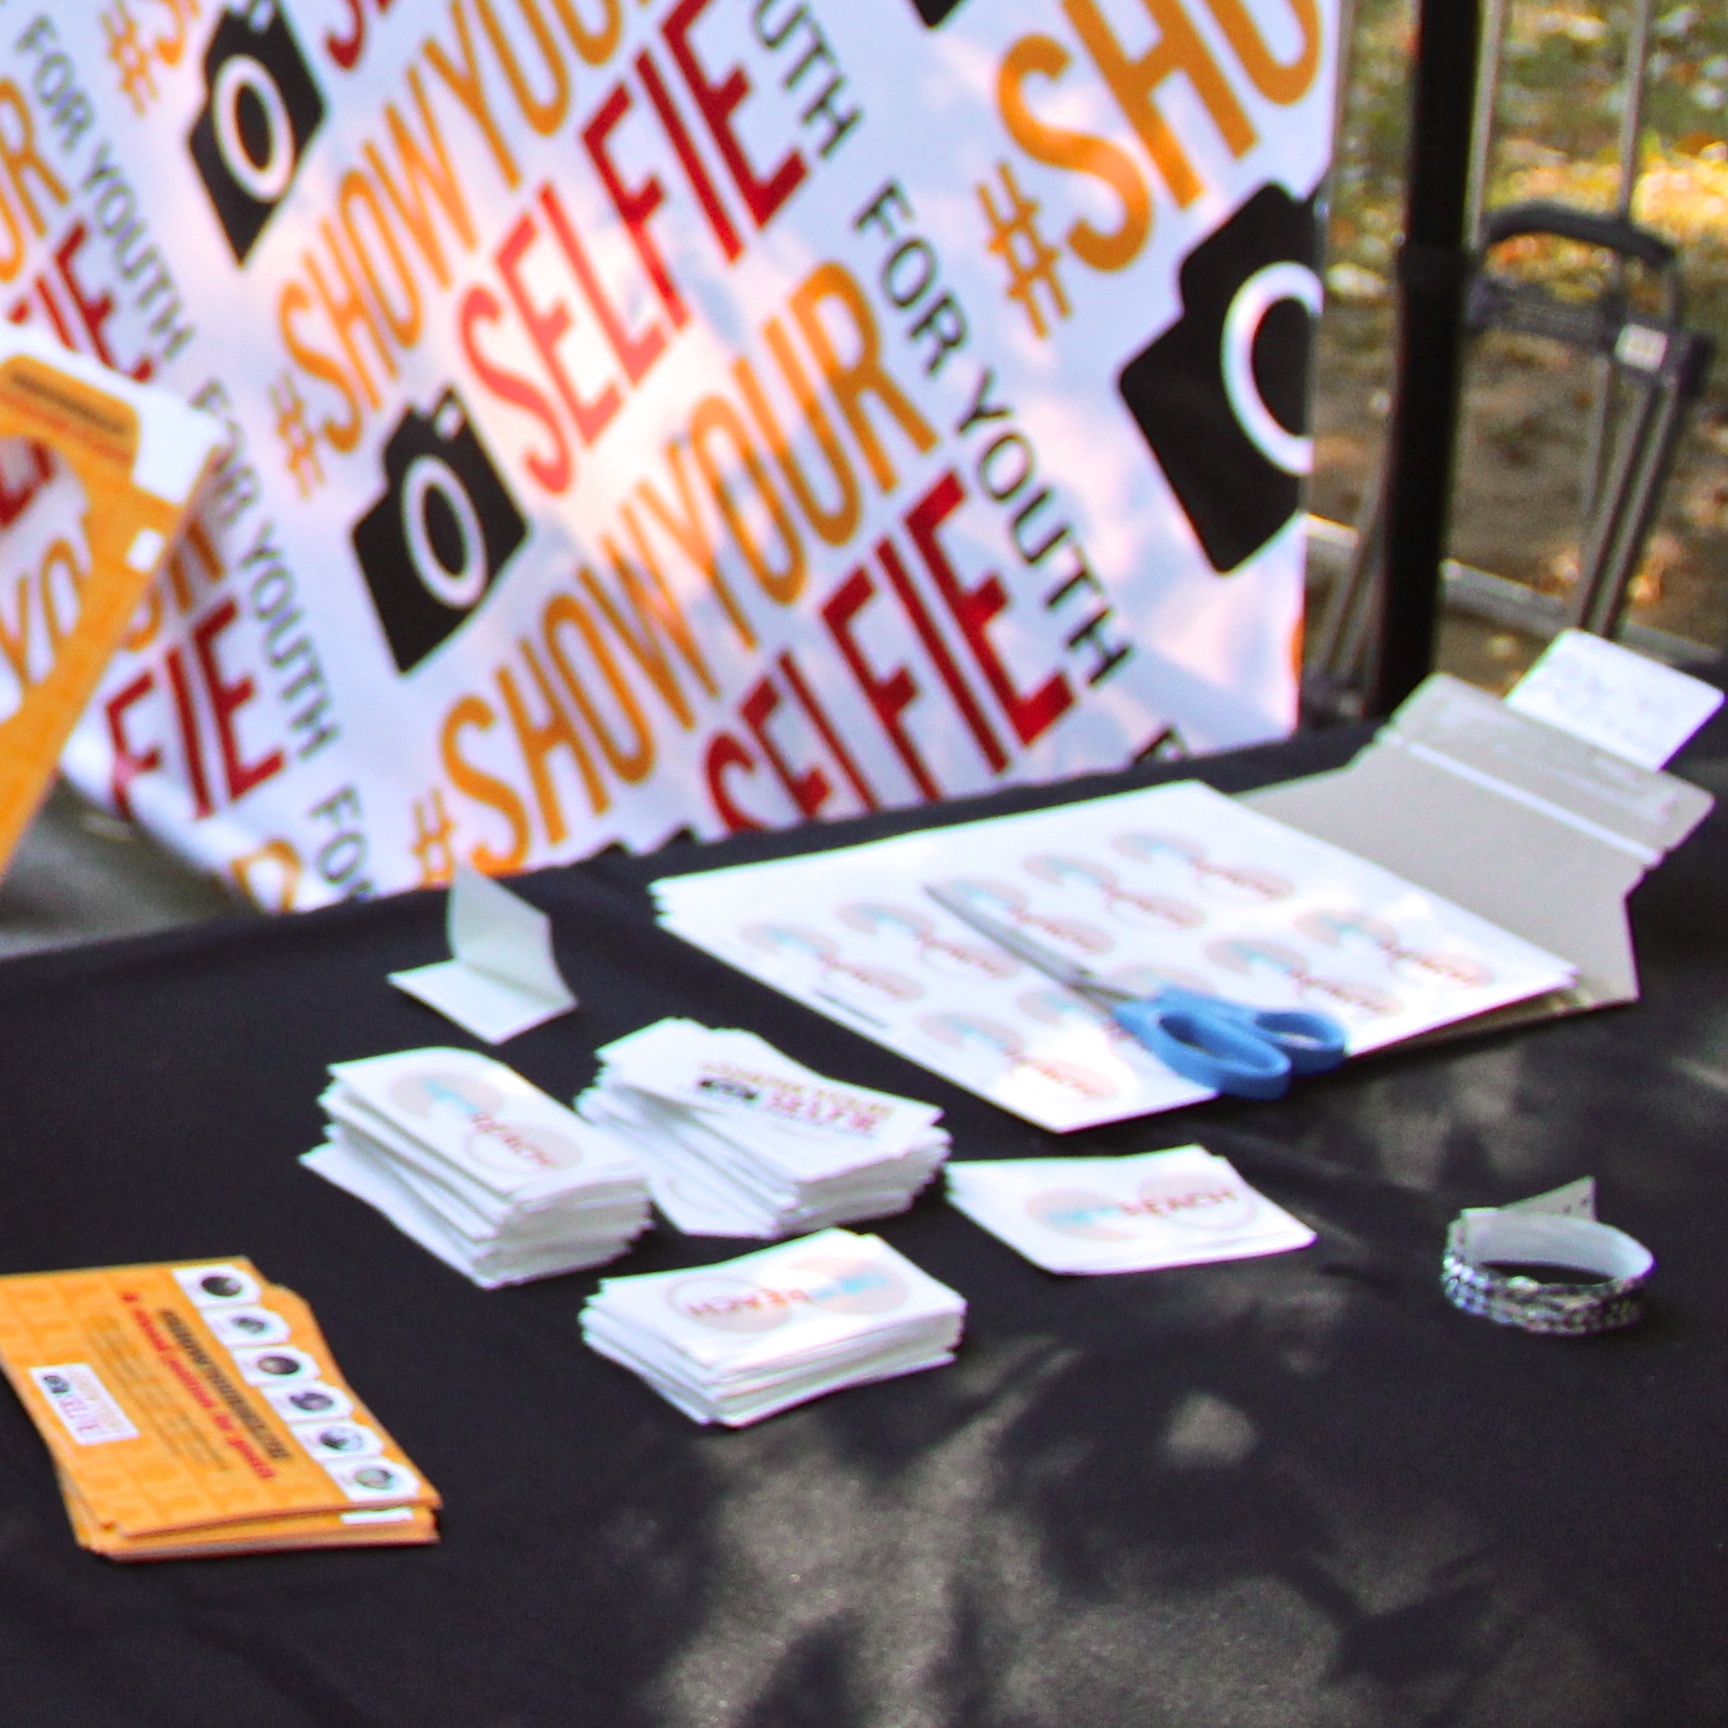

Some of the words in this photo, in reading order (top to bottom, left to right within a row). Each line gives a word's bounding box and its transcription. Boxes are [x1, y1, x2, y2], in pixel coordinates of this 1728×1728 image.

[15, 14, 93, 156] FOR
[78, 132, 196, 362] YOUTH
[242, 518, 341, 762] YOUTH
[410, 260, 939, 889] #SHOWYOUR
[850, 176, 968, 378] FOR
[956, 361, 1136, 692] YOUTH
